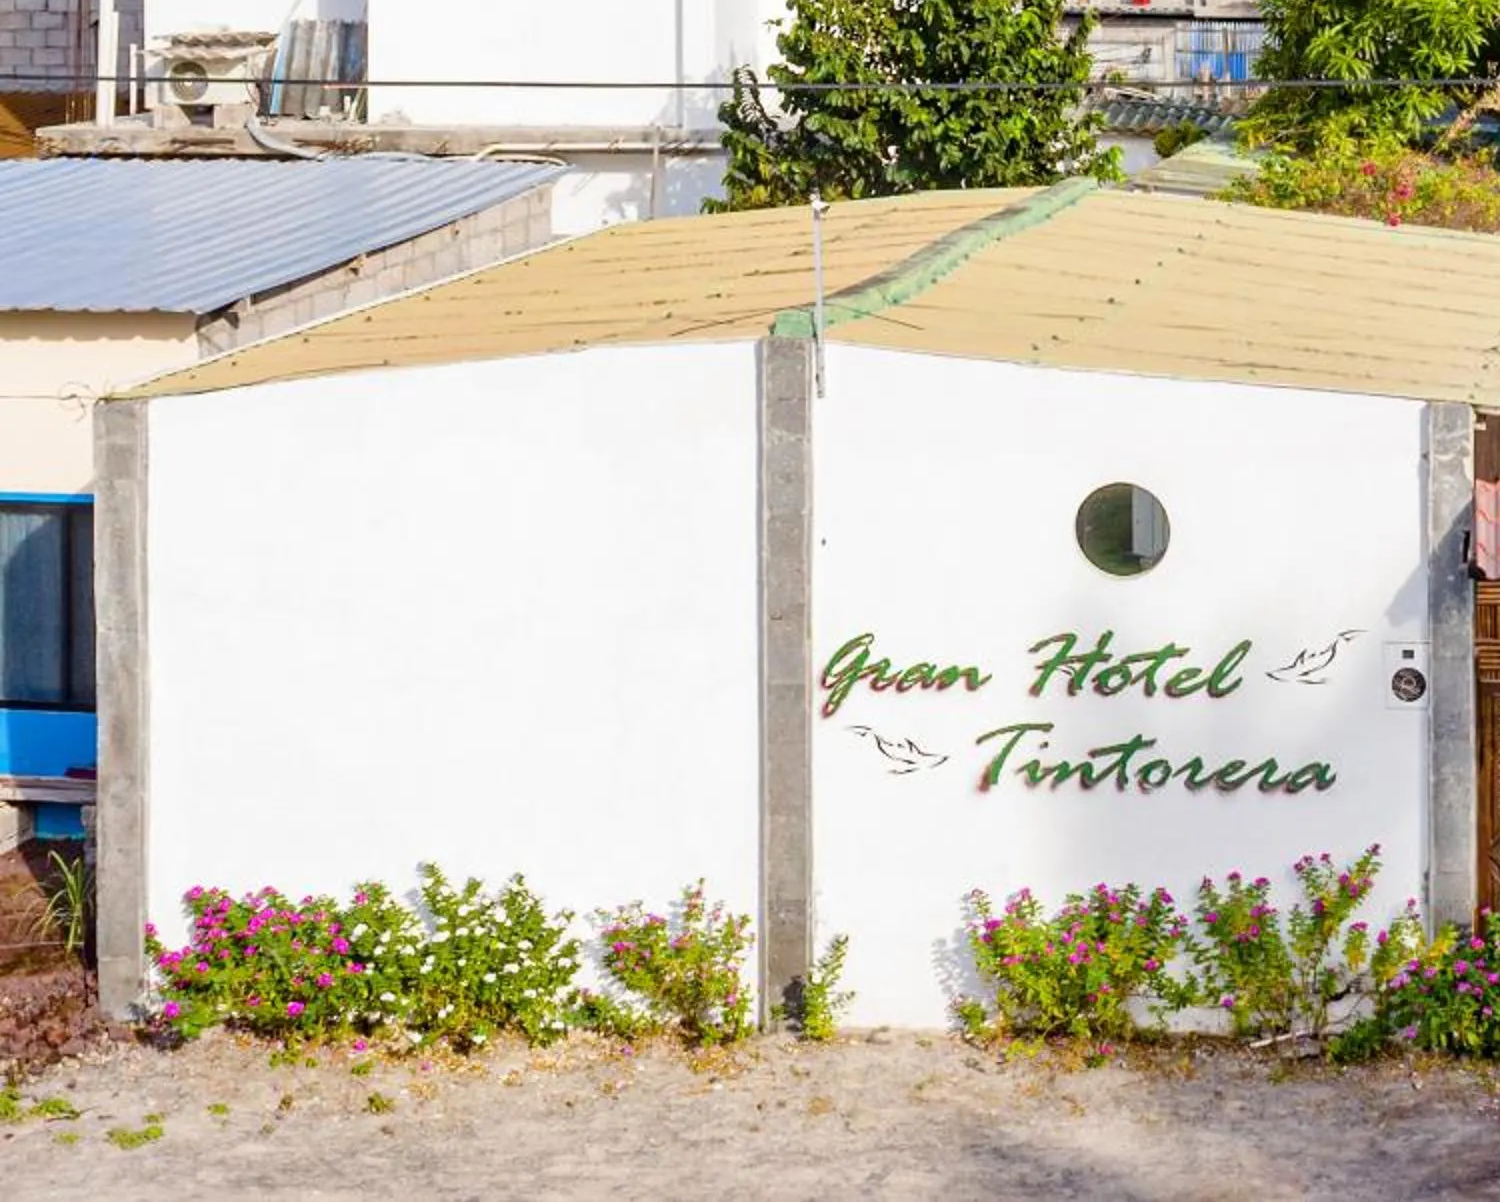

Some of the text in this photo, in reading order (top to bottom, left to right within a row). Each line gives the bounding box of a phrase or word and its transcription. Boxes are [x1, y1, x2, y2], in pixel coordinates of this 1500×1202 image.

[822, 630, 1252, 718] Gran Hotel
[975, 723, 1337, 795] Tintorera
